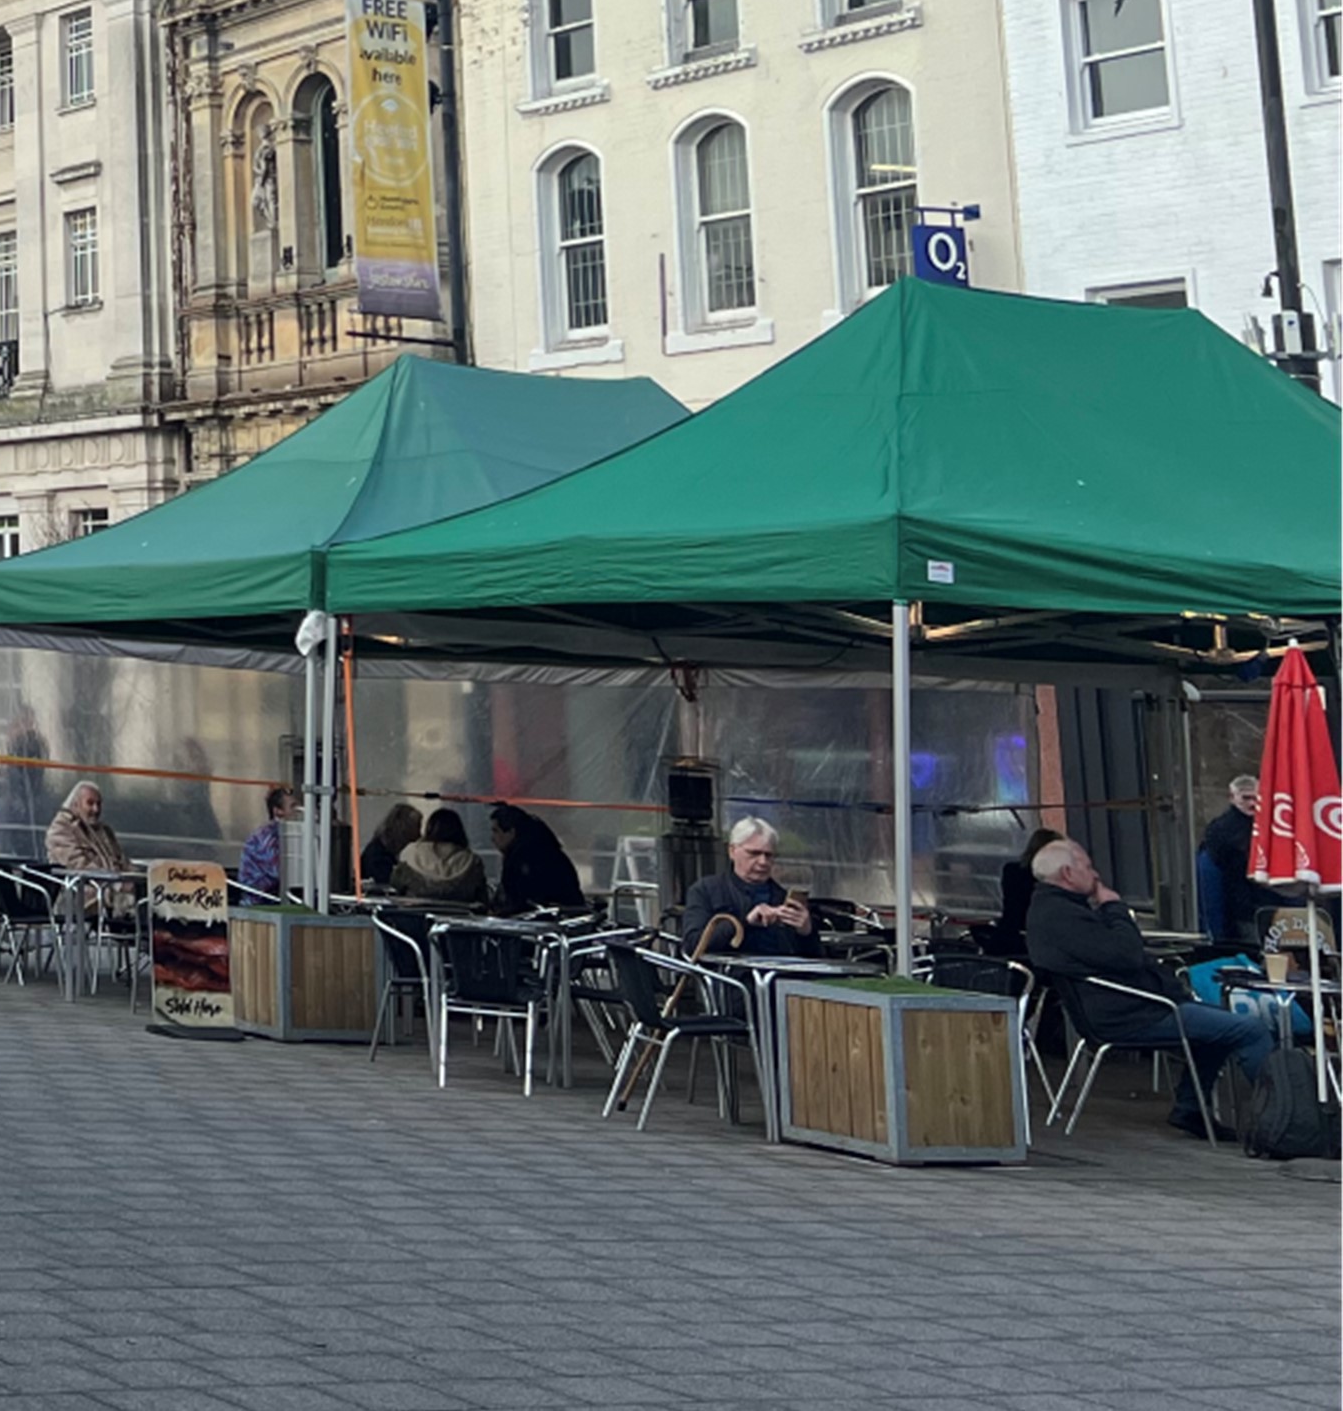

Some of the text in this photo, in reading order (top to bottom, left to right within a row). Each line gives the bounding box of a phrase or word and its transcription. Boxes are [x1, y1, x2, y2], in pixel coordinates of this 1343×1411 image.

[365, 19, 408, 43] WiFi
[372, 67, 402, 86] here
[153, 885, 224, 910] Bacon Rolls
[1264, 919, 1289, 953] HOT
[165, 997, 192, 1013] Sold
